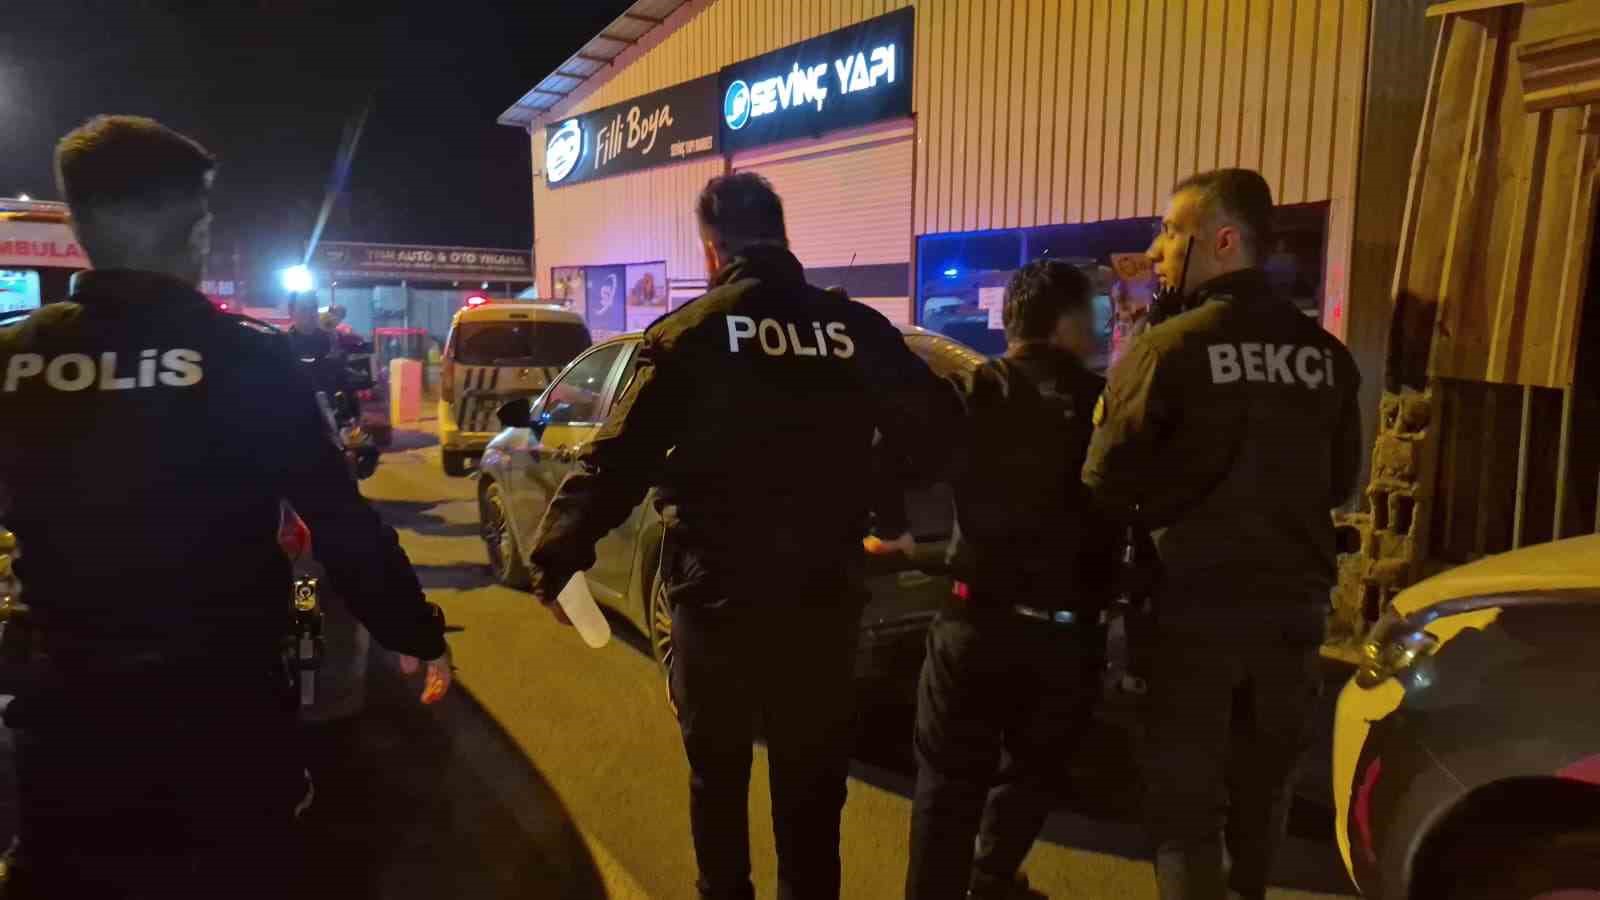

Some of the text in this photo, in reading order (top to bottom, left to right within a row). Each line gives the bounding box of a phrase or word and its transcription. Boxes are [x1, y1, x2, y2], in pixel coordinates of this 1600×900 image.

[834, 43, 896, 95] YAPI
[594, 113, 625, 169] Filli
[626, 104, 674, 154] Boya
[397, 250, 434, 262] AUTO
[450, 252, 477, 264] OTO
